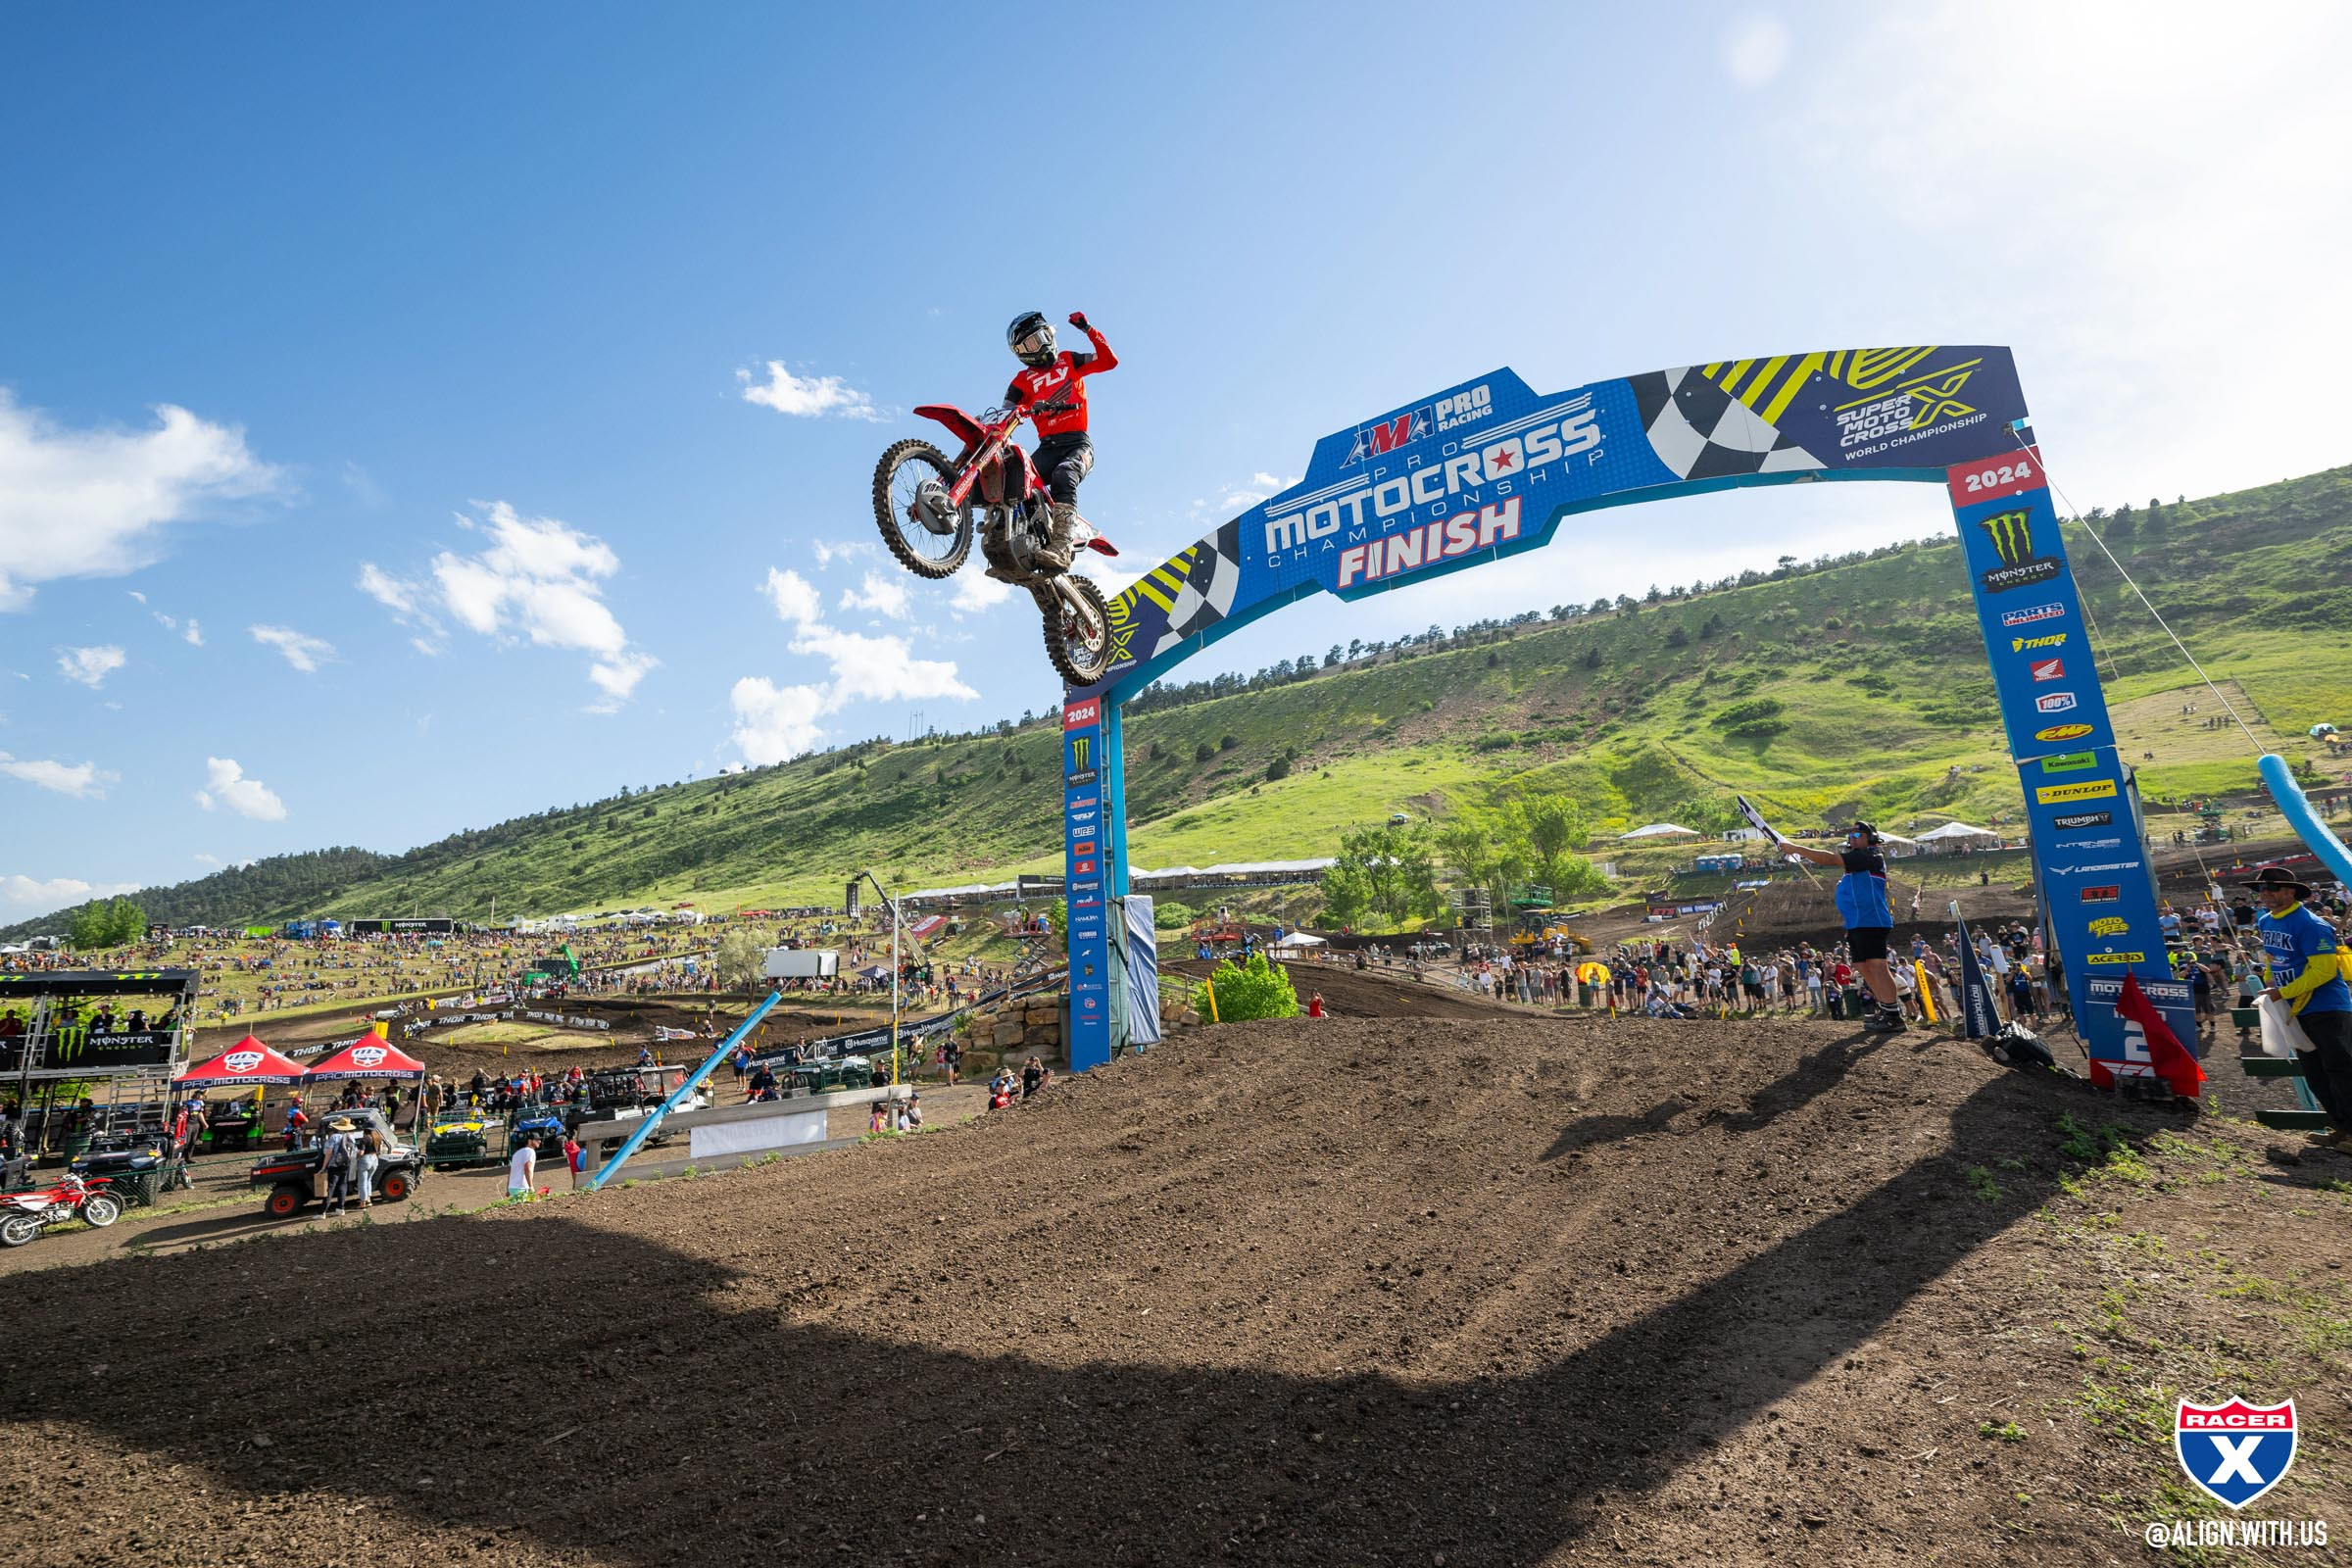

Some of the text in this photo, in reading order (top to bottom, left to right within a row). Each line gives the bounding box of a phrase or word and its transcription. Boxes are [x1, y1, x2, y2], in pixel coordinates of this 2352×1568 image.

[1032, 366, 1069, 394] FLY
[1435, 384, 1492, 423] PRO
[1837, 394, 1912, 426] SUPER
[1438, 405, 1494, 433] RACING
[1842, 407, 1911, 435] MOTO
[1339, 405, 1437, 470] AMA
[1840, 416, 1914, 448] CROSS
[1844, 413, 1987, 462] WORLD CHAMPIONSHIP
[1374, 440, 1458, 482] PRO
[1265, 408, 1601, 555] MOTOCROSS
[1965, 462, 2032, 493] 2024
[1268, 449, 1604, 568] CHAMPIONSHIP
[1338, 494, 1523, 589] FINISH
[1987, 562, 2055, 583] MONSTER
[1998, 573, 2045, 587] ENERGY
[2002, 603, 2063, 621] PARTS
[2004, 610, 2065, 626] UNLIMITED
[2025, 633, 2068, 650] THOR
[1106, 659, 1137, 672] MPIONSHIP
[2035, 673, 2063, 682] HONDA
[2041, 695, 2071, 710] 100%
[1067, 706, 1096, 723] 2024
[2035, 724, 2093, 741] FMF
[2047, 758, 2090, 768] Kawasaki
[2052, 784, 2113, 797] DUNLOP
[2054, 814, 2100, 826] TRIUMPH
[2075, 861, 2139, 873] LANDMASTER
[2088, 916, 2125, 933] MOTO
[2095, 923, 2130, 939] TEES
[2089, 983, 2189, 998] MOTCROSS
[438, 1015, 466, 1024] THOR
[472, 1012, 497, 1021] THOR
[1972, 984, 1986, 1036] MOTOCROSS
[89, 1035, 154, 1047] MONSTER
[853, 1035, 888, 1048] Husqvarna
[293, 1044, 325, 1057] THOR
[181, 1076, 291, 1090] PROMOTOCROSS
[315, 1070, 415, 1082] PROMOTOCROSS
